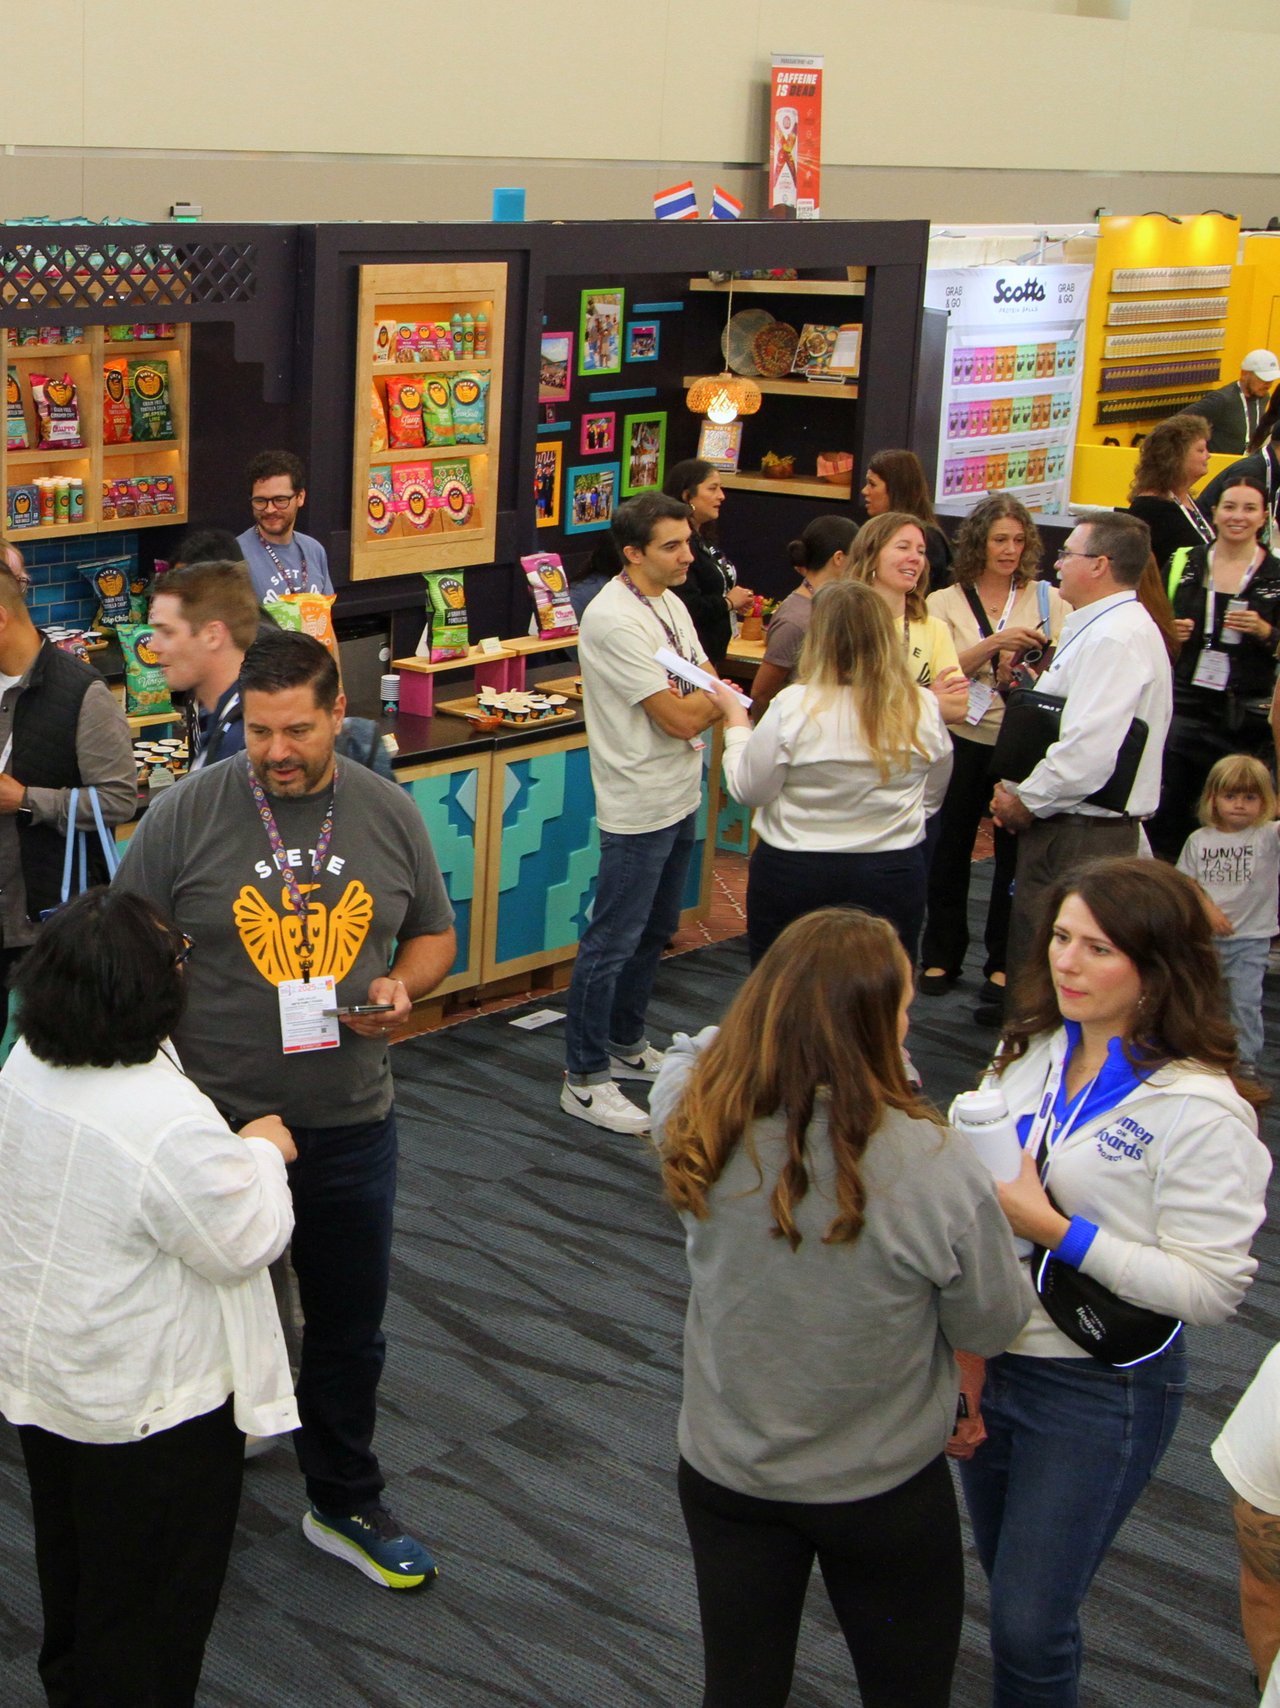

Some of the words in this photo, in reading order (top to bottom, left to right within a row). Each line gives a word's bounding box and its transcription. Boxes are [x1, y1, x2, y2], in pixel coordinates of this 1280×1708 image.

[776, 73, 818, 84] CAFFEINE
[776, 84, 788, 97] IS
[789, 86, 816, 97] DEAD
[945, 286, 963, 296] GRAB
[993, 277, 1046, 304] Scotts
[1058, 283, 1075, 292] GRAB
[945, 300, 950, 308] &
[951, 299, 961, 308] GO
[1058, 295, 1063, 303] &
[1064, 294, 1073, 303] GO
[100, 569, 117, 577] SIETE
[101, 616, 115, 625] Dip
[1202, 858, 1251, 871] TASTE
[1202, 870, 1252, 882] TESTER
[1097, 1144, 1122, 1161] PROJECT
